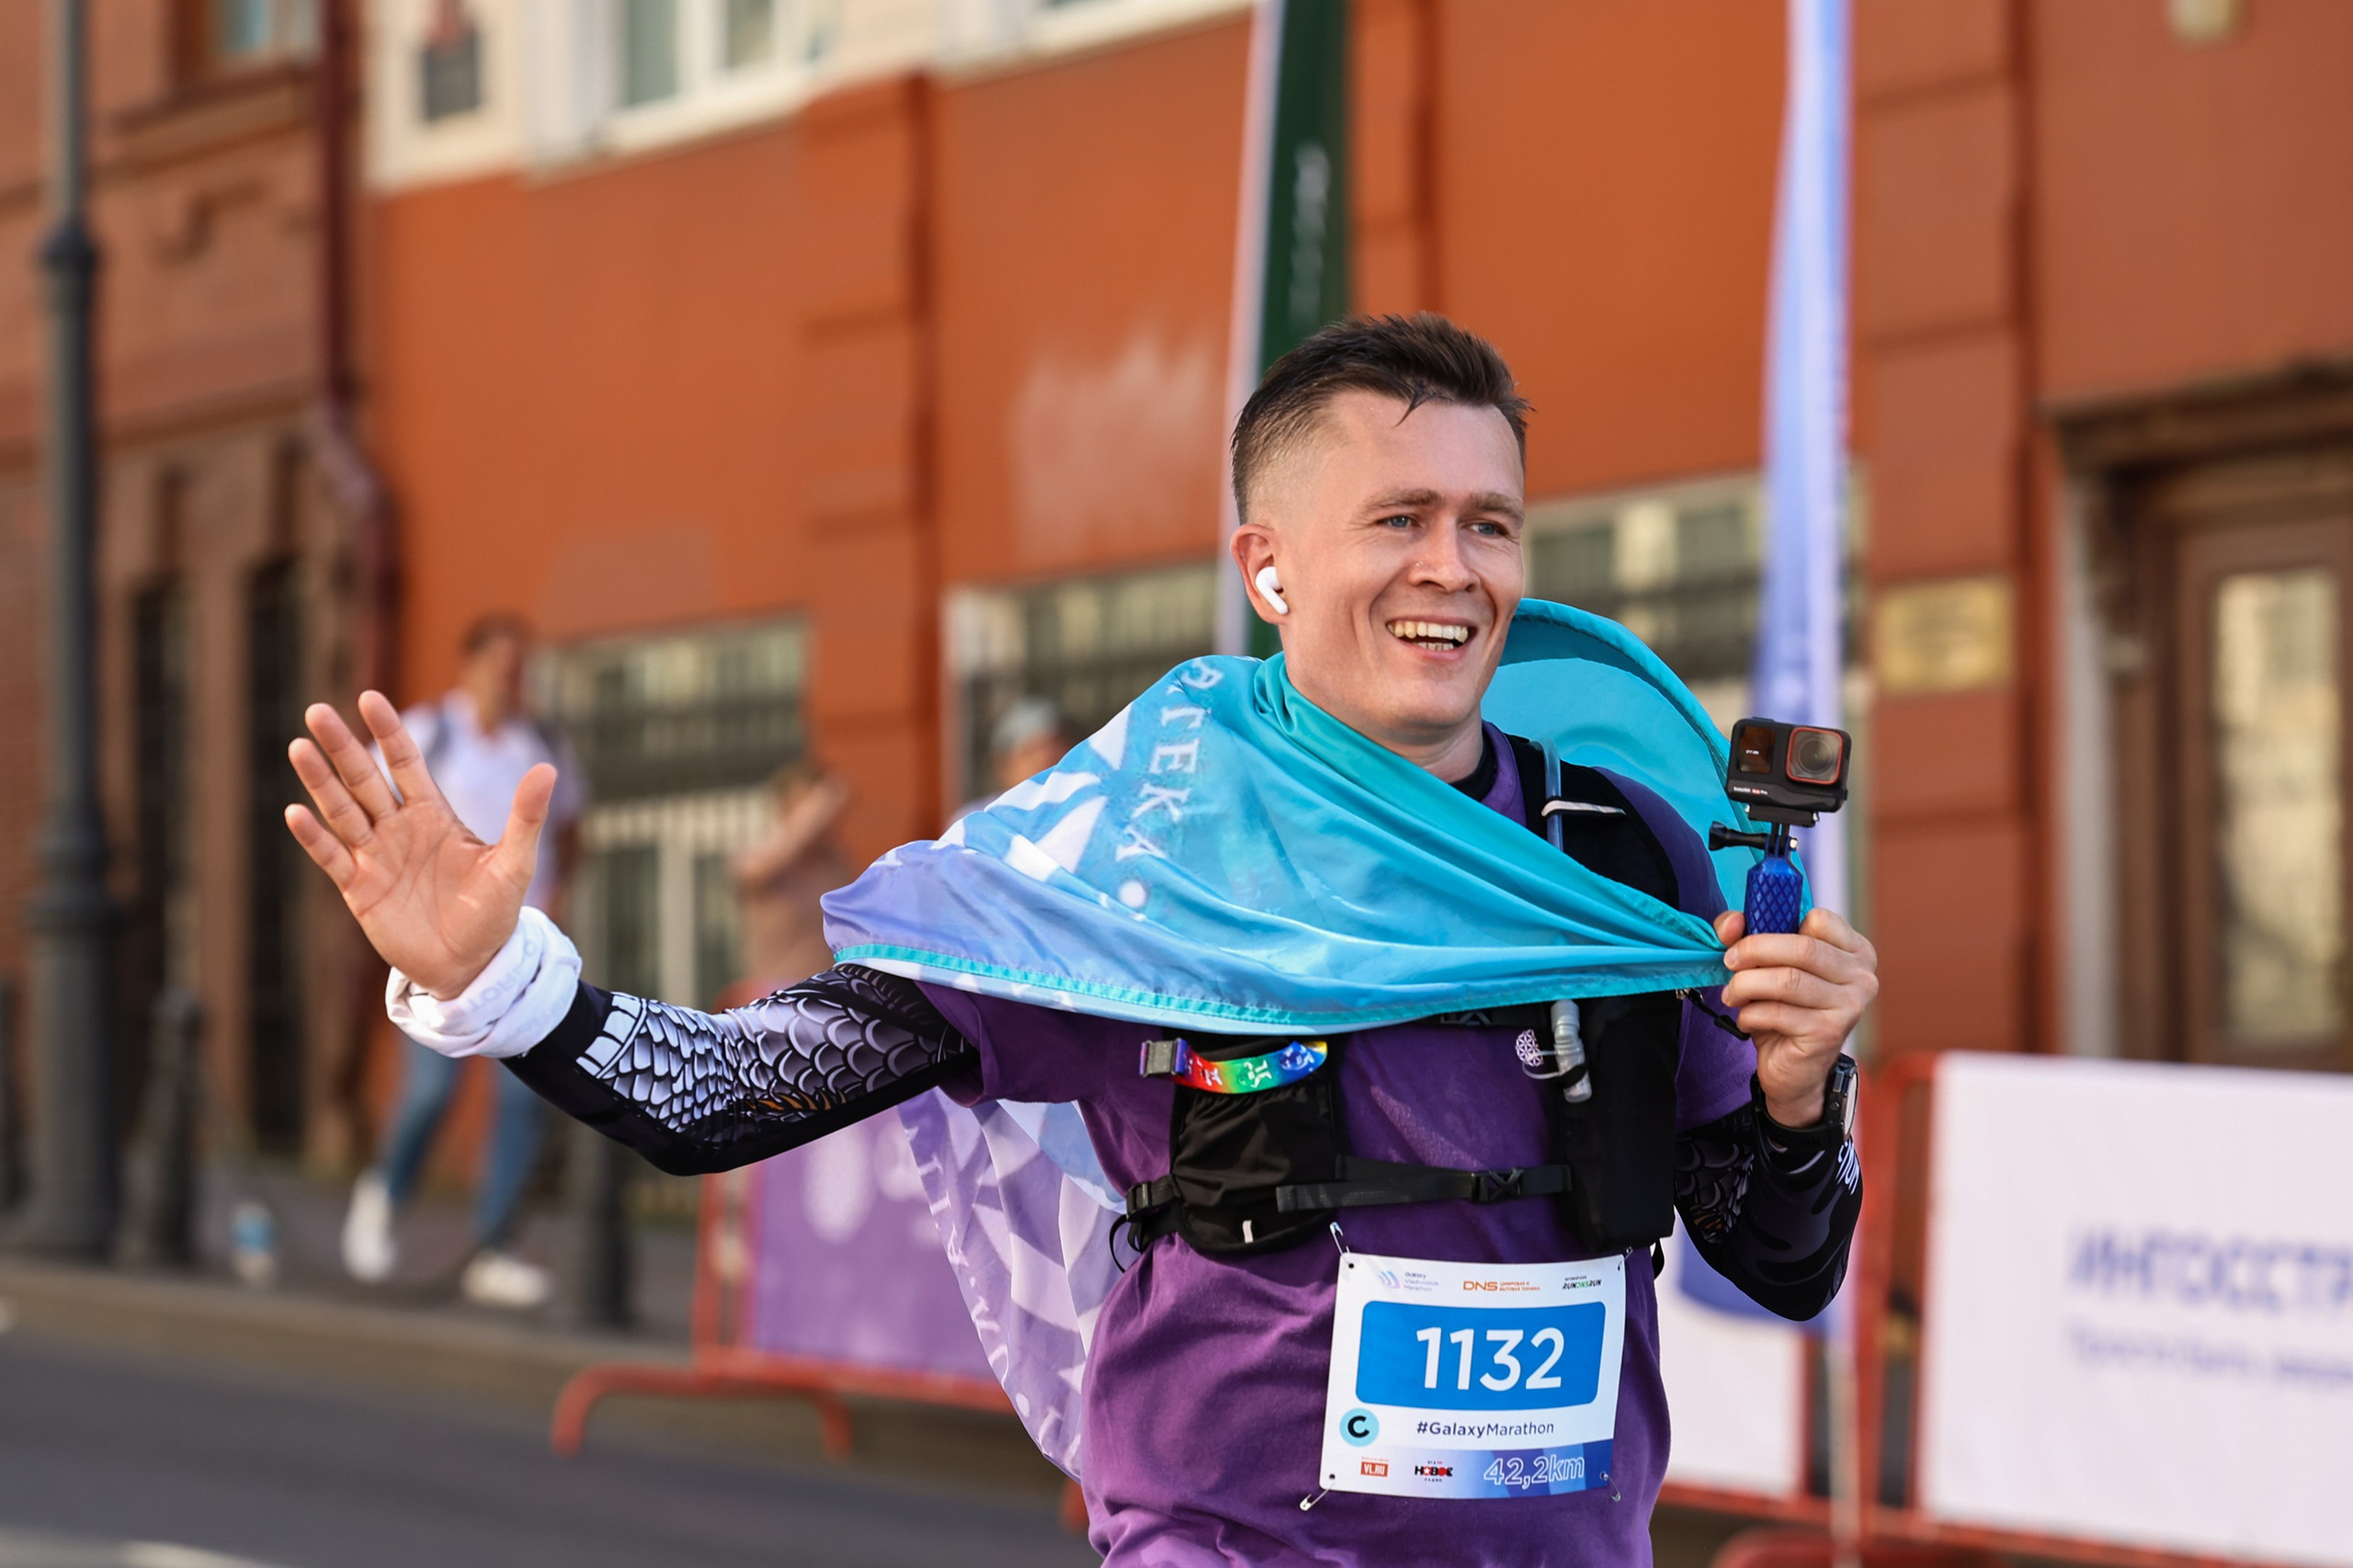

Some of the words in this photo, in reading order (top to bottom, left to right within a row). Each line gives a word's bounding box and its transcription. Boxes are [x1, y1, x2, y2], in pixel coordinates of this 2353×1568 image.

[1463, 1280, 1497, 1291] DNS
[1416, 1326, 1564, 1392] 1132
[1416, 1421, 1554, 1438] #GalaxyMarathon
[1363, 1462, 1386, 1475] VL.RU
[1483, 1454, 1586, 1490] 42,2km
